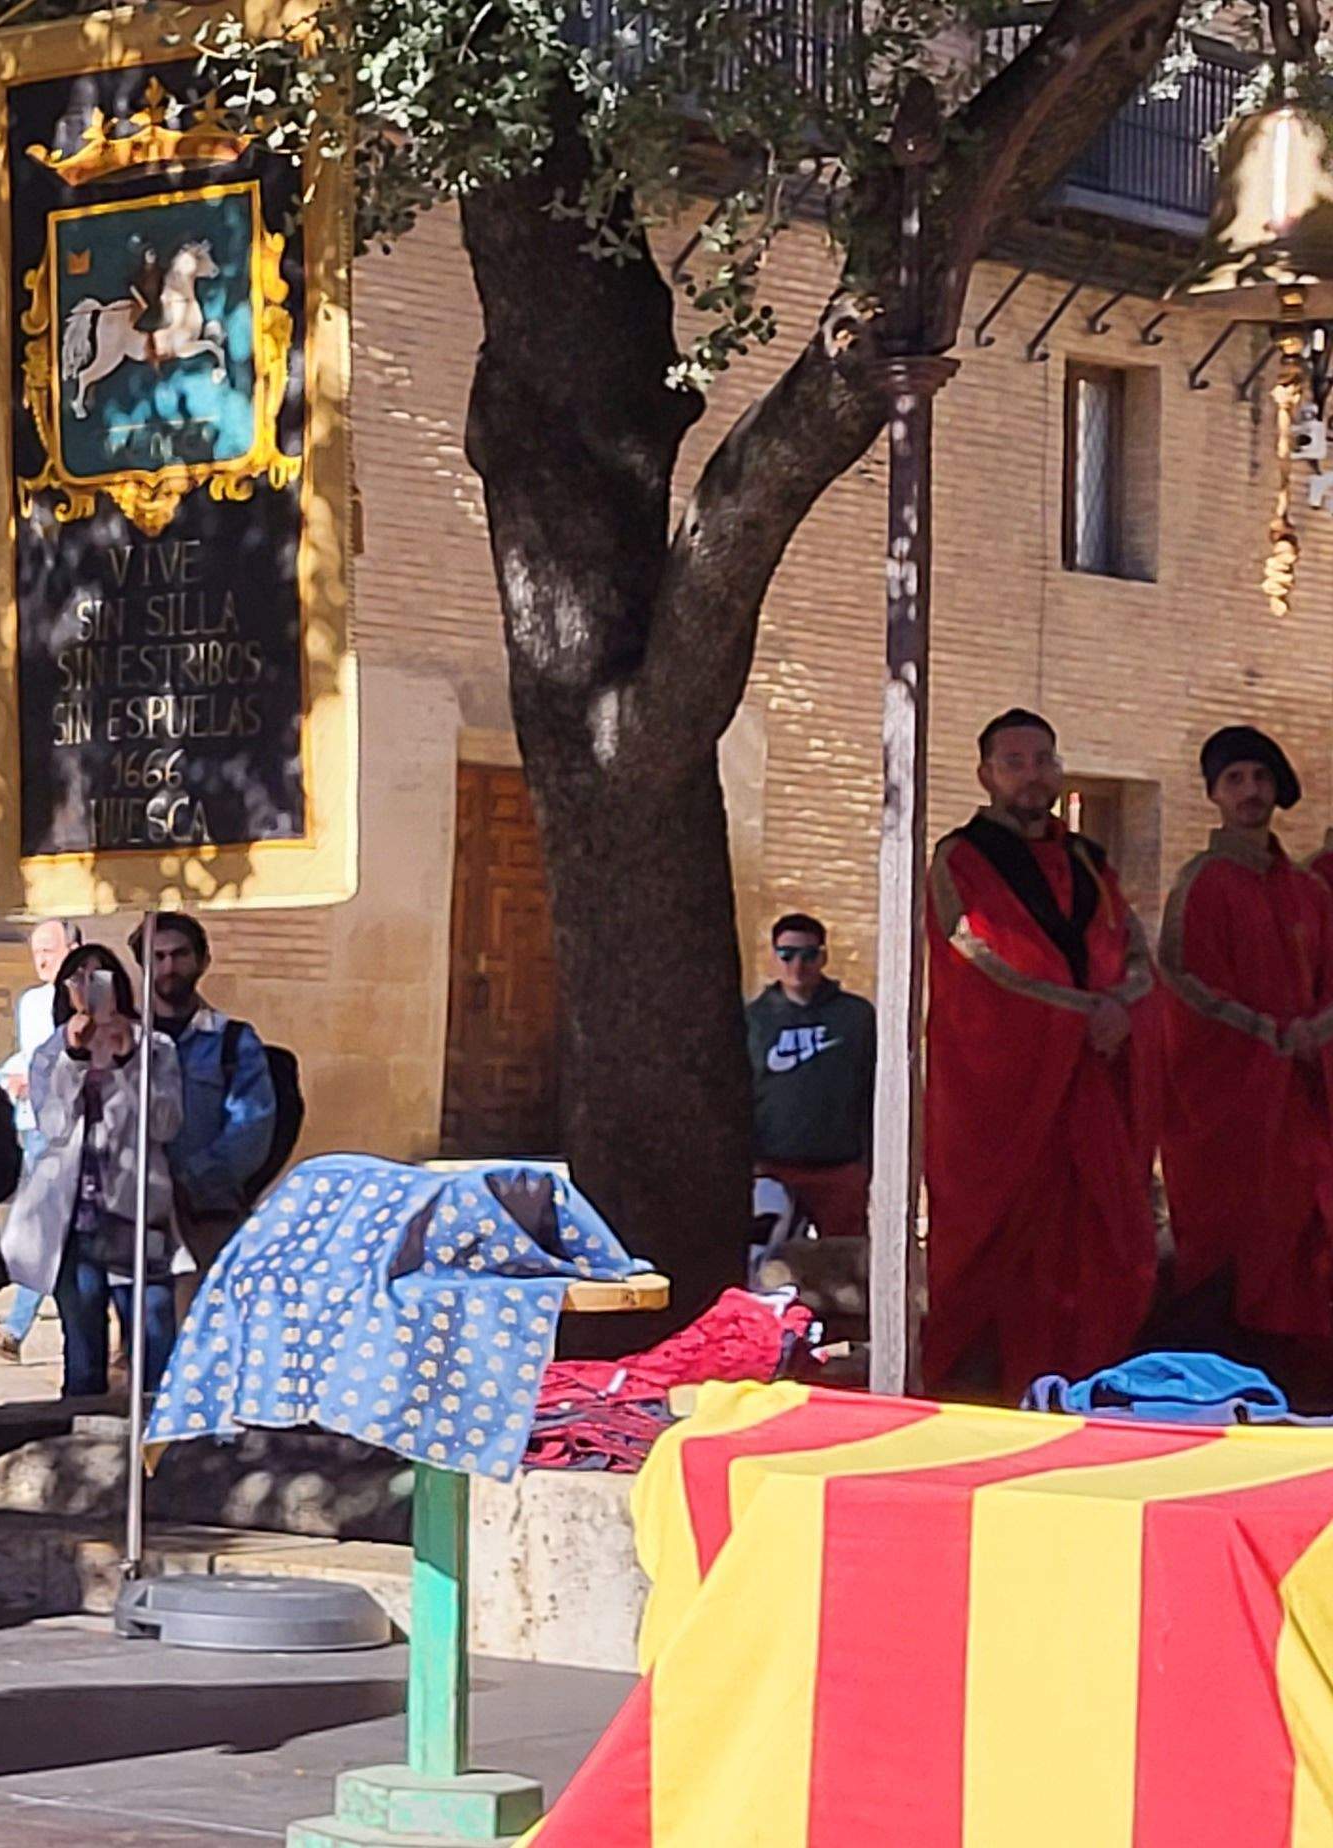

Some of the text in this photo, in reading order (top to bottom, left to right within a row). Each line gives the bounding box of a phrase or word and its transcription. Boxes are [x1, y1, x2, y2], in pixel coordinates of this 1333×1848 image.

[107, 539, 201, 588] VIVE
[76, 589, 240, 643] SIN SILLA
[57, 639, 263, 692] SIN ESTRIBOS
[51, 693, 263, 747] SIN ESPUELAS
[110, 748, 186, 790] 1666
